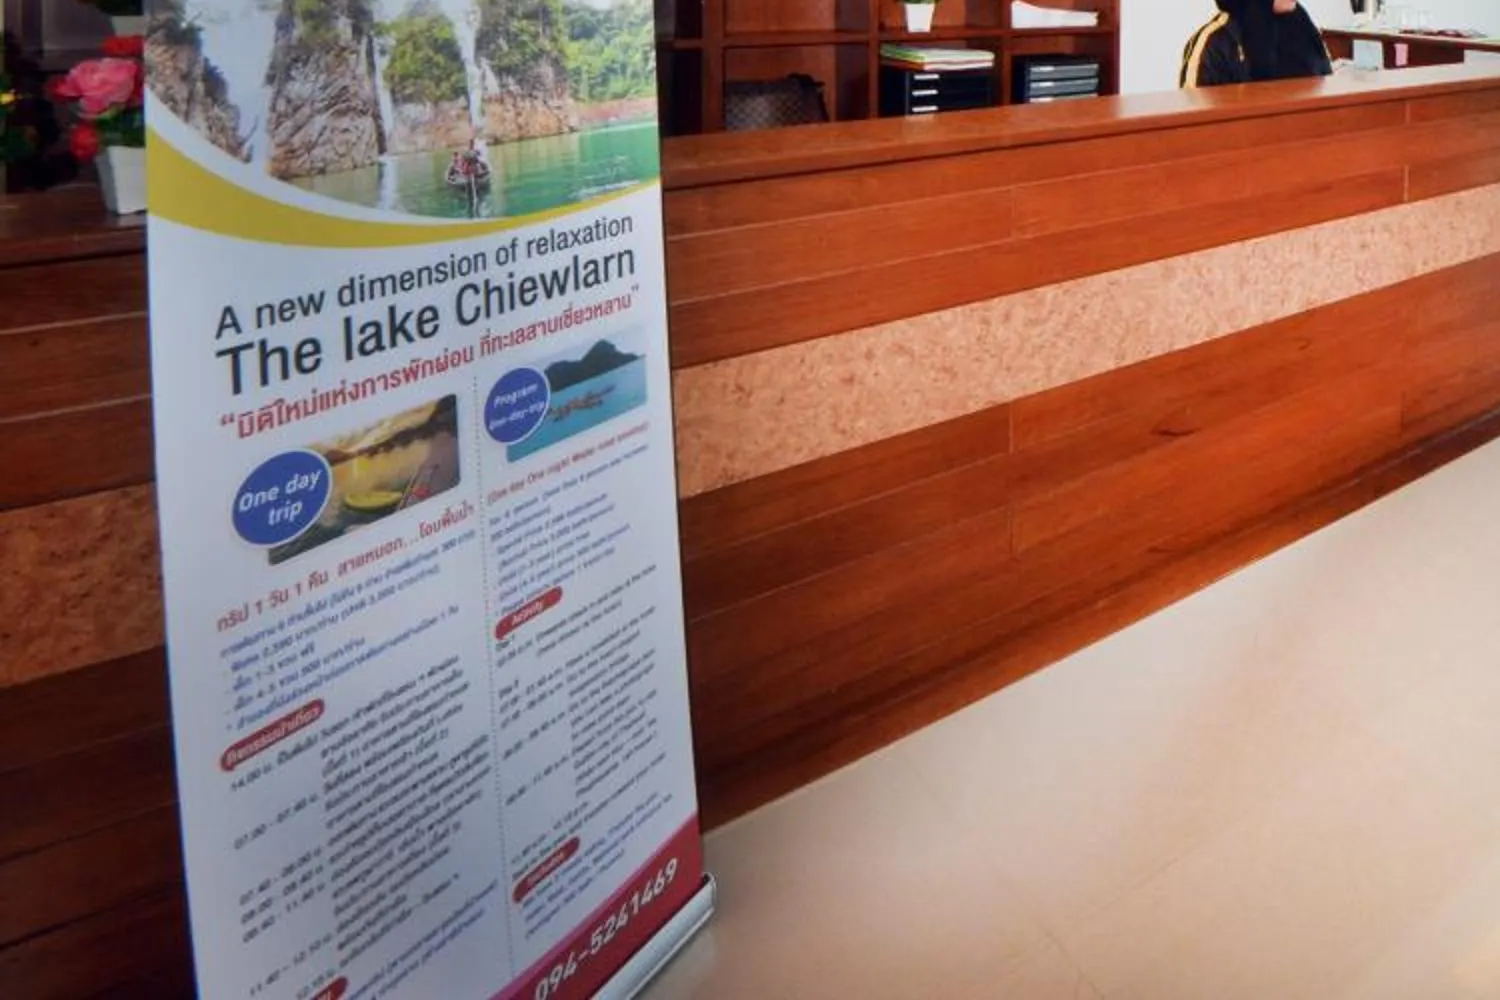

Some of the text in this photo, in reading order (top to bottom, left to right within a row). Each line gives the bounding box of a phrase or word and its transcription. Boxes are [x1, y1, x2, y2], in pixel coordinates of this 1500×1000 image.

[214, 213, 633, 340] A new dimension of relaxation
[216, 247, 636, 396] The lake Chiewlarn
[238, 468, 323, 513] One day
[267, 500, 304, 527] trip
[535, 857, 678, 1000] 094-5241469
